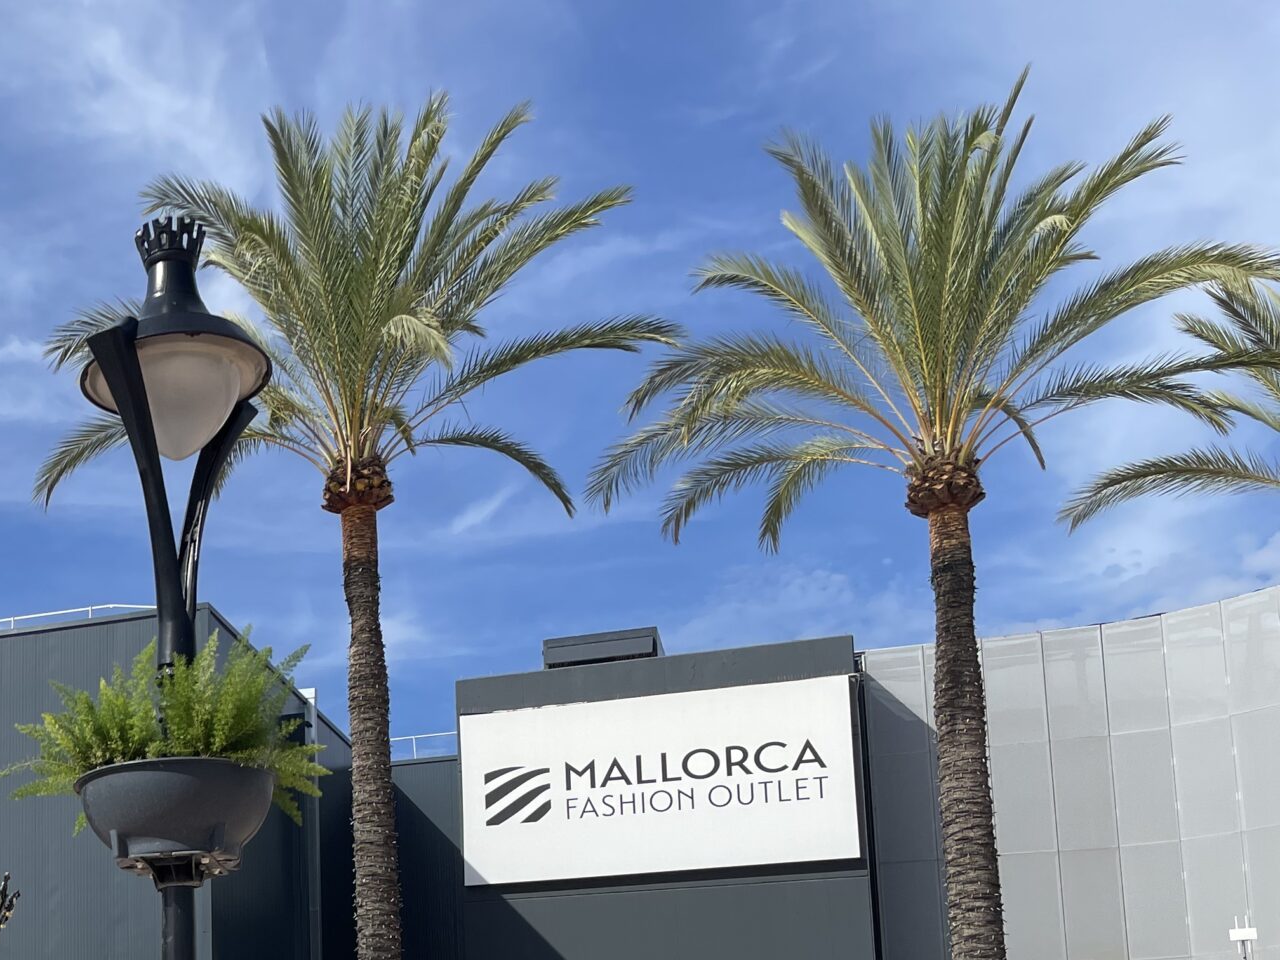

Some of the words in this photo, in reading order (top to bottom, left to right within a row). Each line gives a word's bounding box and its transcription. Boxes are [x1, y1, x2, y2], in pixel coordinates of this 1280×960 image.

[565, 738, 828, 791] MALLORCA
[566, 787, 695, 820] FASHION
[708, 776, 829, 808] OUTLET
